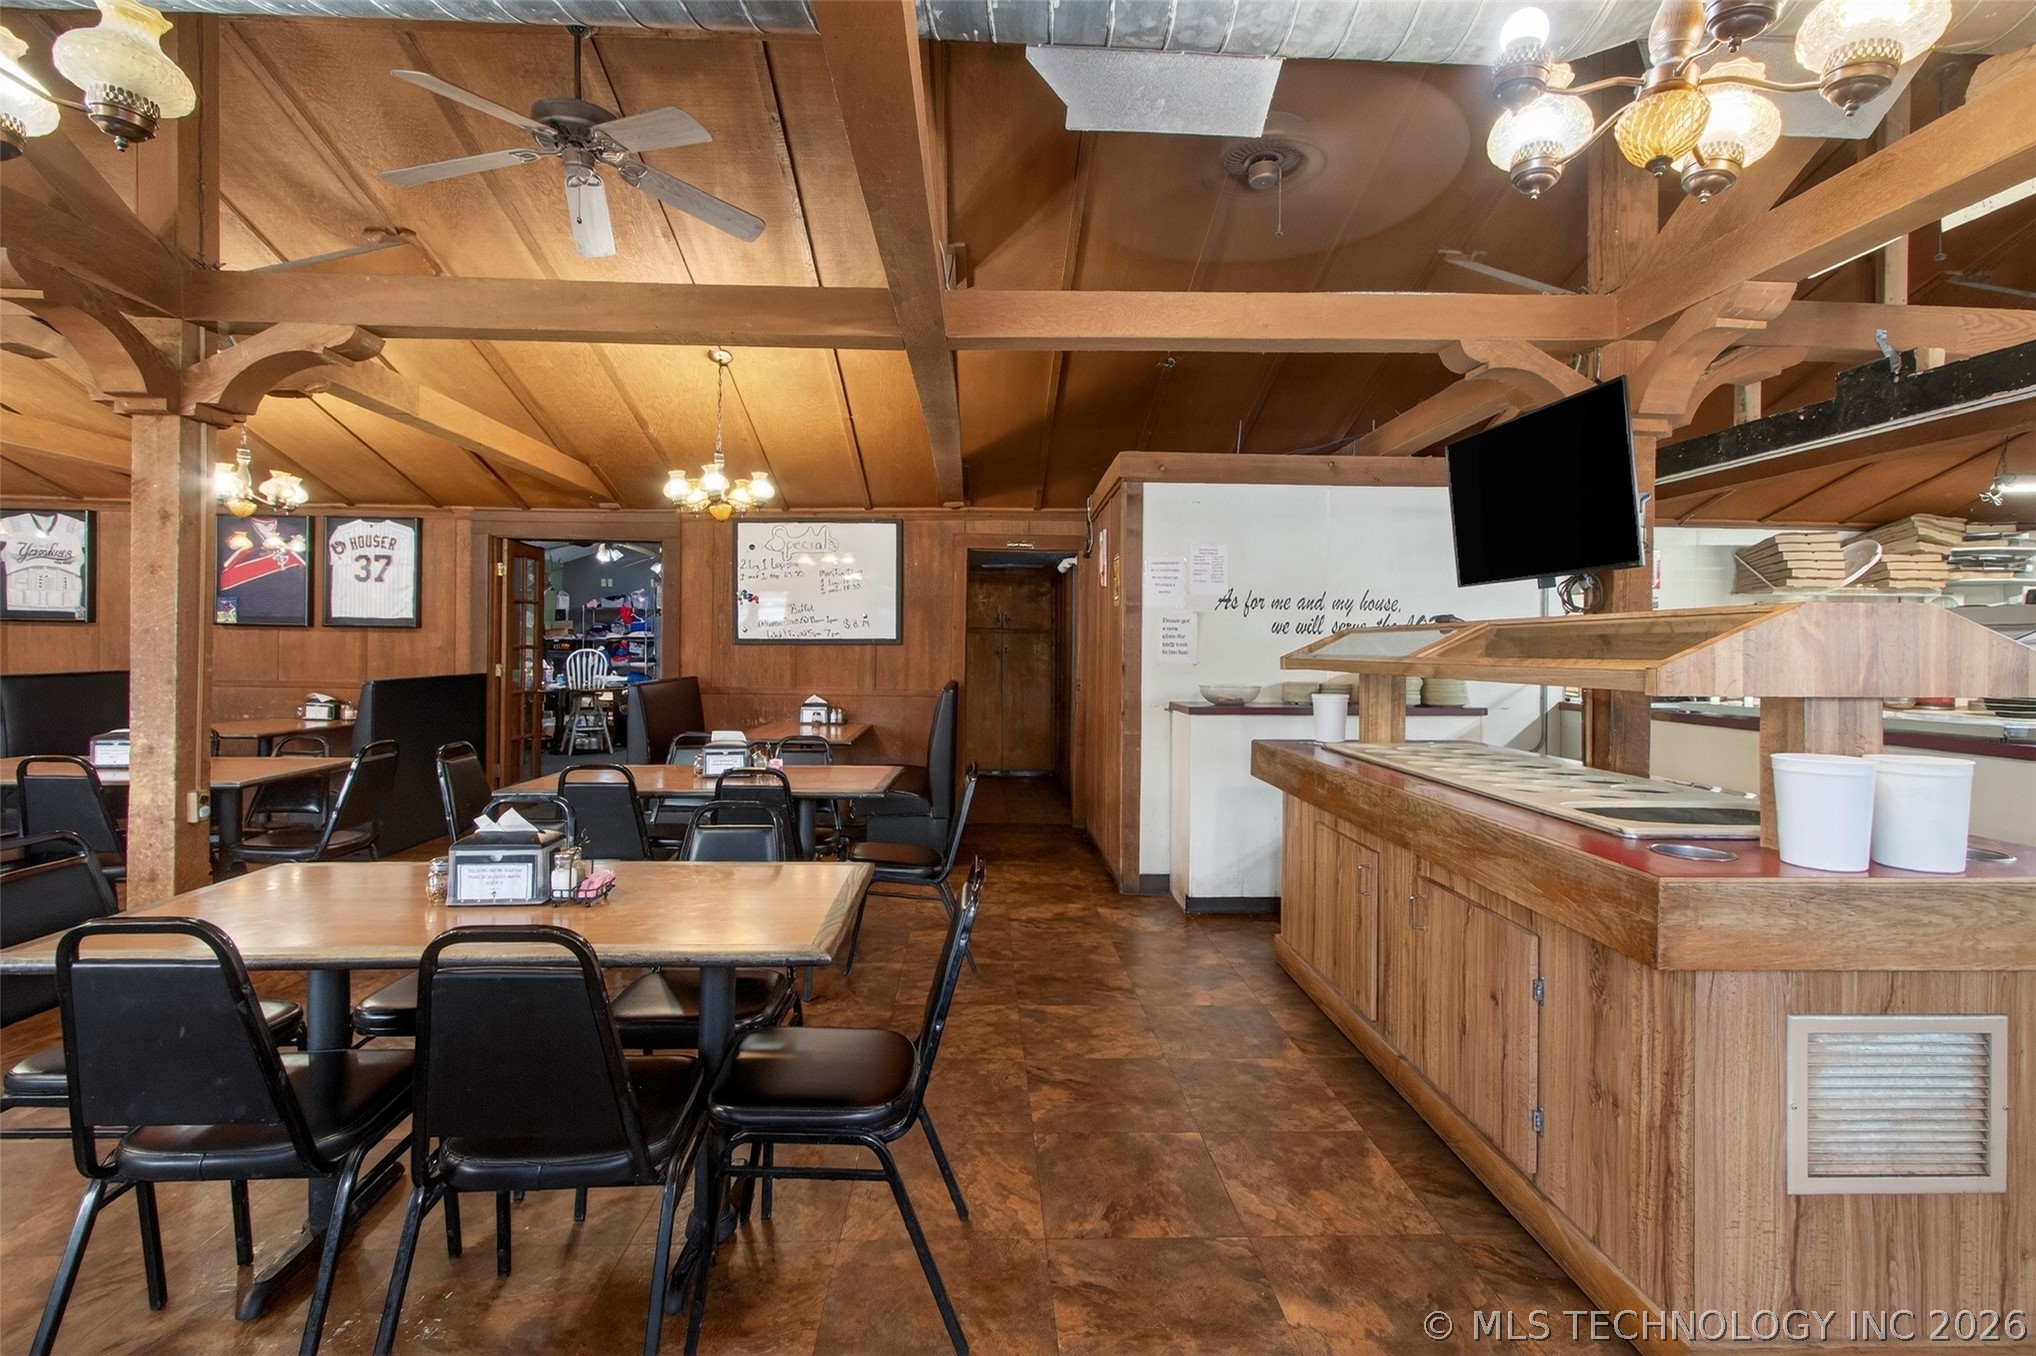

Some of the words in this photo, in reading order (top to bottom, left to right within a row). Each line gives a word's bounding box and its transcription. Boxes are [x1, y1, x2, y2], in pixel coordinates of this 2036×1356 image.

[17, 541, 73, 563] Yankees
[349, 534, 397, 551] HOUSER
[354, 554, 392, 583] 37
[1214, 587, 1239, 610] As
[1243, 589, 1265, 617] for
[1271, 597, 1291, 611] me
[1296, 591, 1326, 611] and
[1332, 598, 1354, 617] my
[1271, 621, 1290, 634] we
[1295, 614, 1325, 635] will
